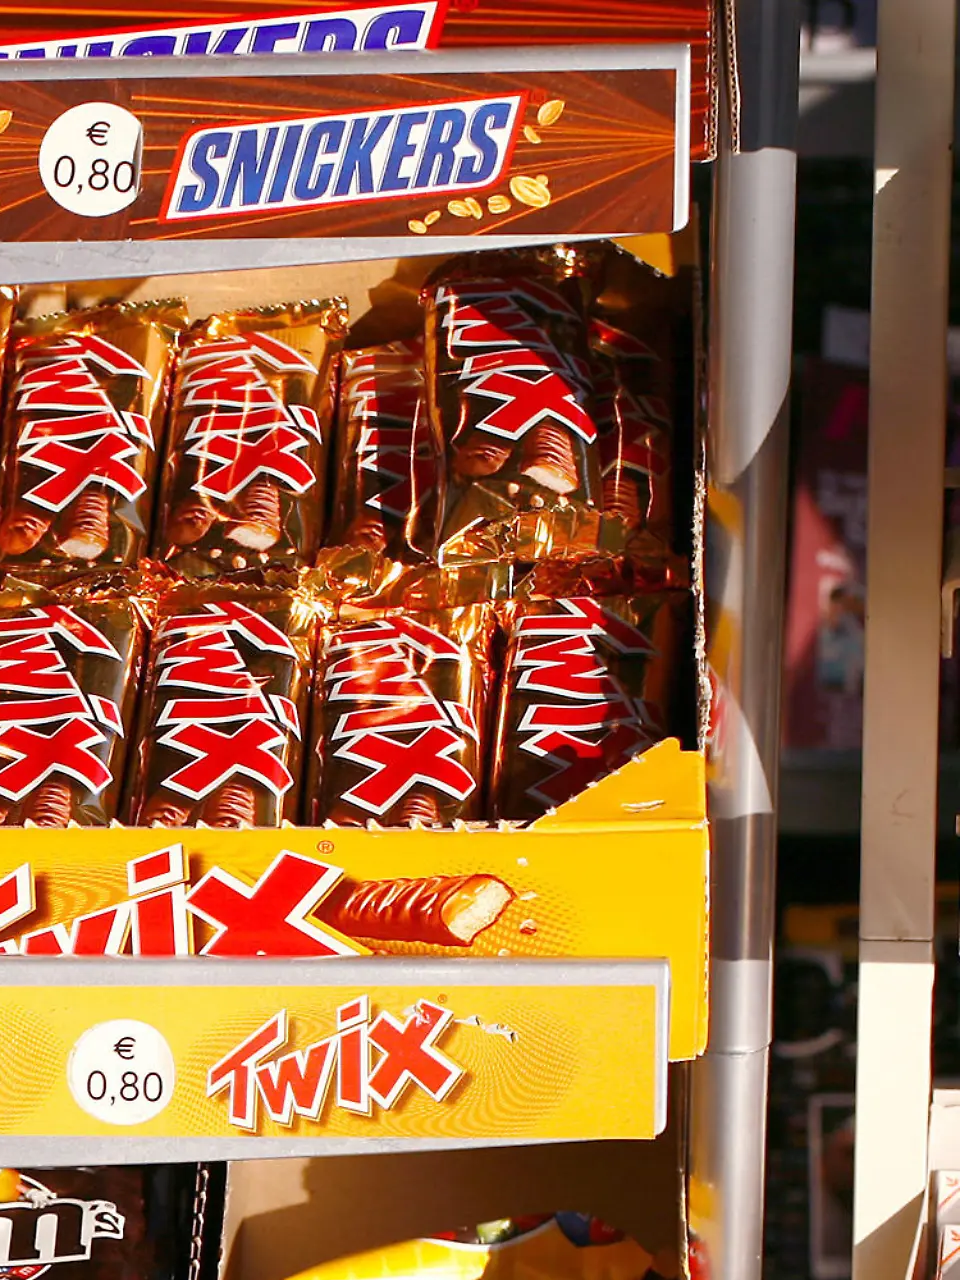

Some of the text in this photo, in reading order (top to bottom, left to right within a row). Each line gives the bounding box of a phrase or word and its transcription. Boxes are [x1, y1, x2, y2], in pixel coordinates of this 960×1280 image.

[85, 120, 112, 147] €
[53, 155, 136, 195] 0,80
[178, 102, 512, 213] SNICKERS
[113, 1036, 136, 1061] €
[86, 1070, 164, 1108] 0,80
